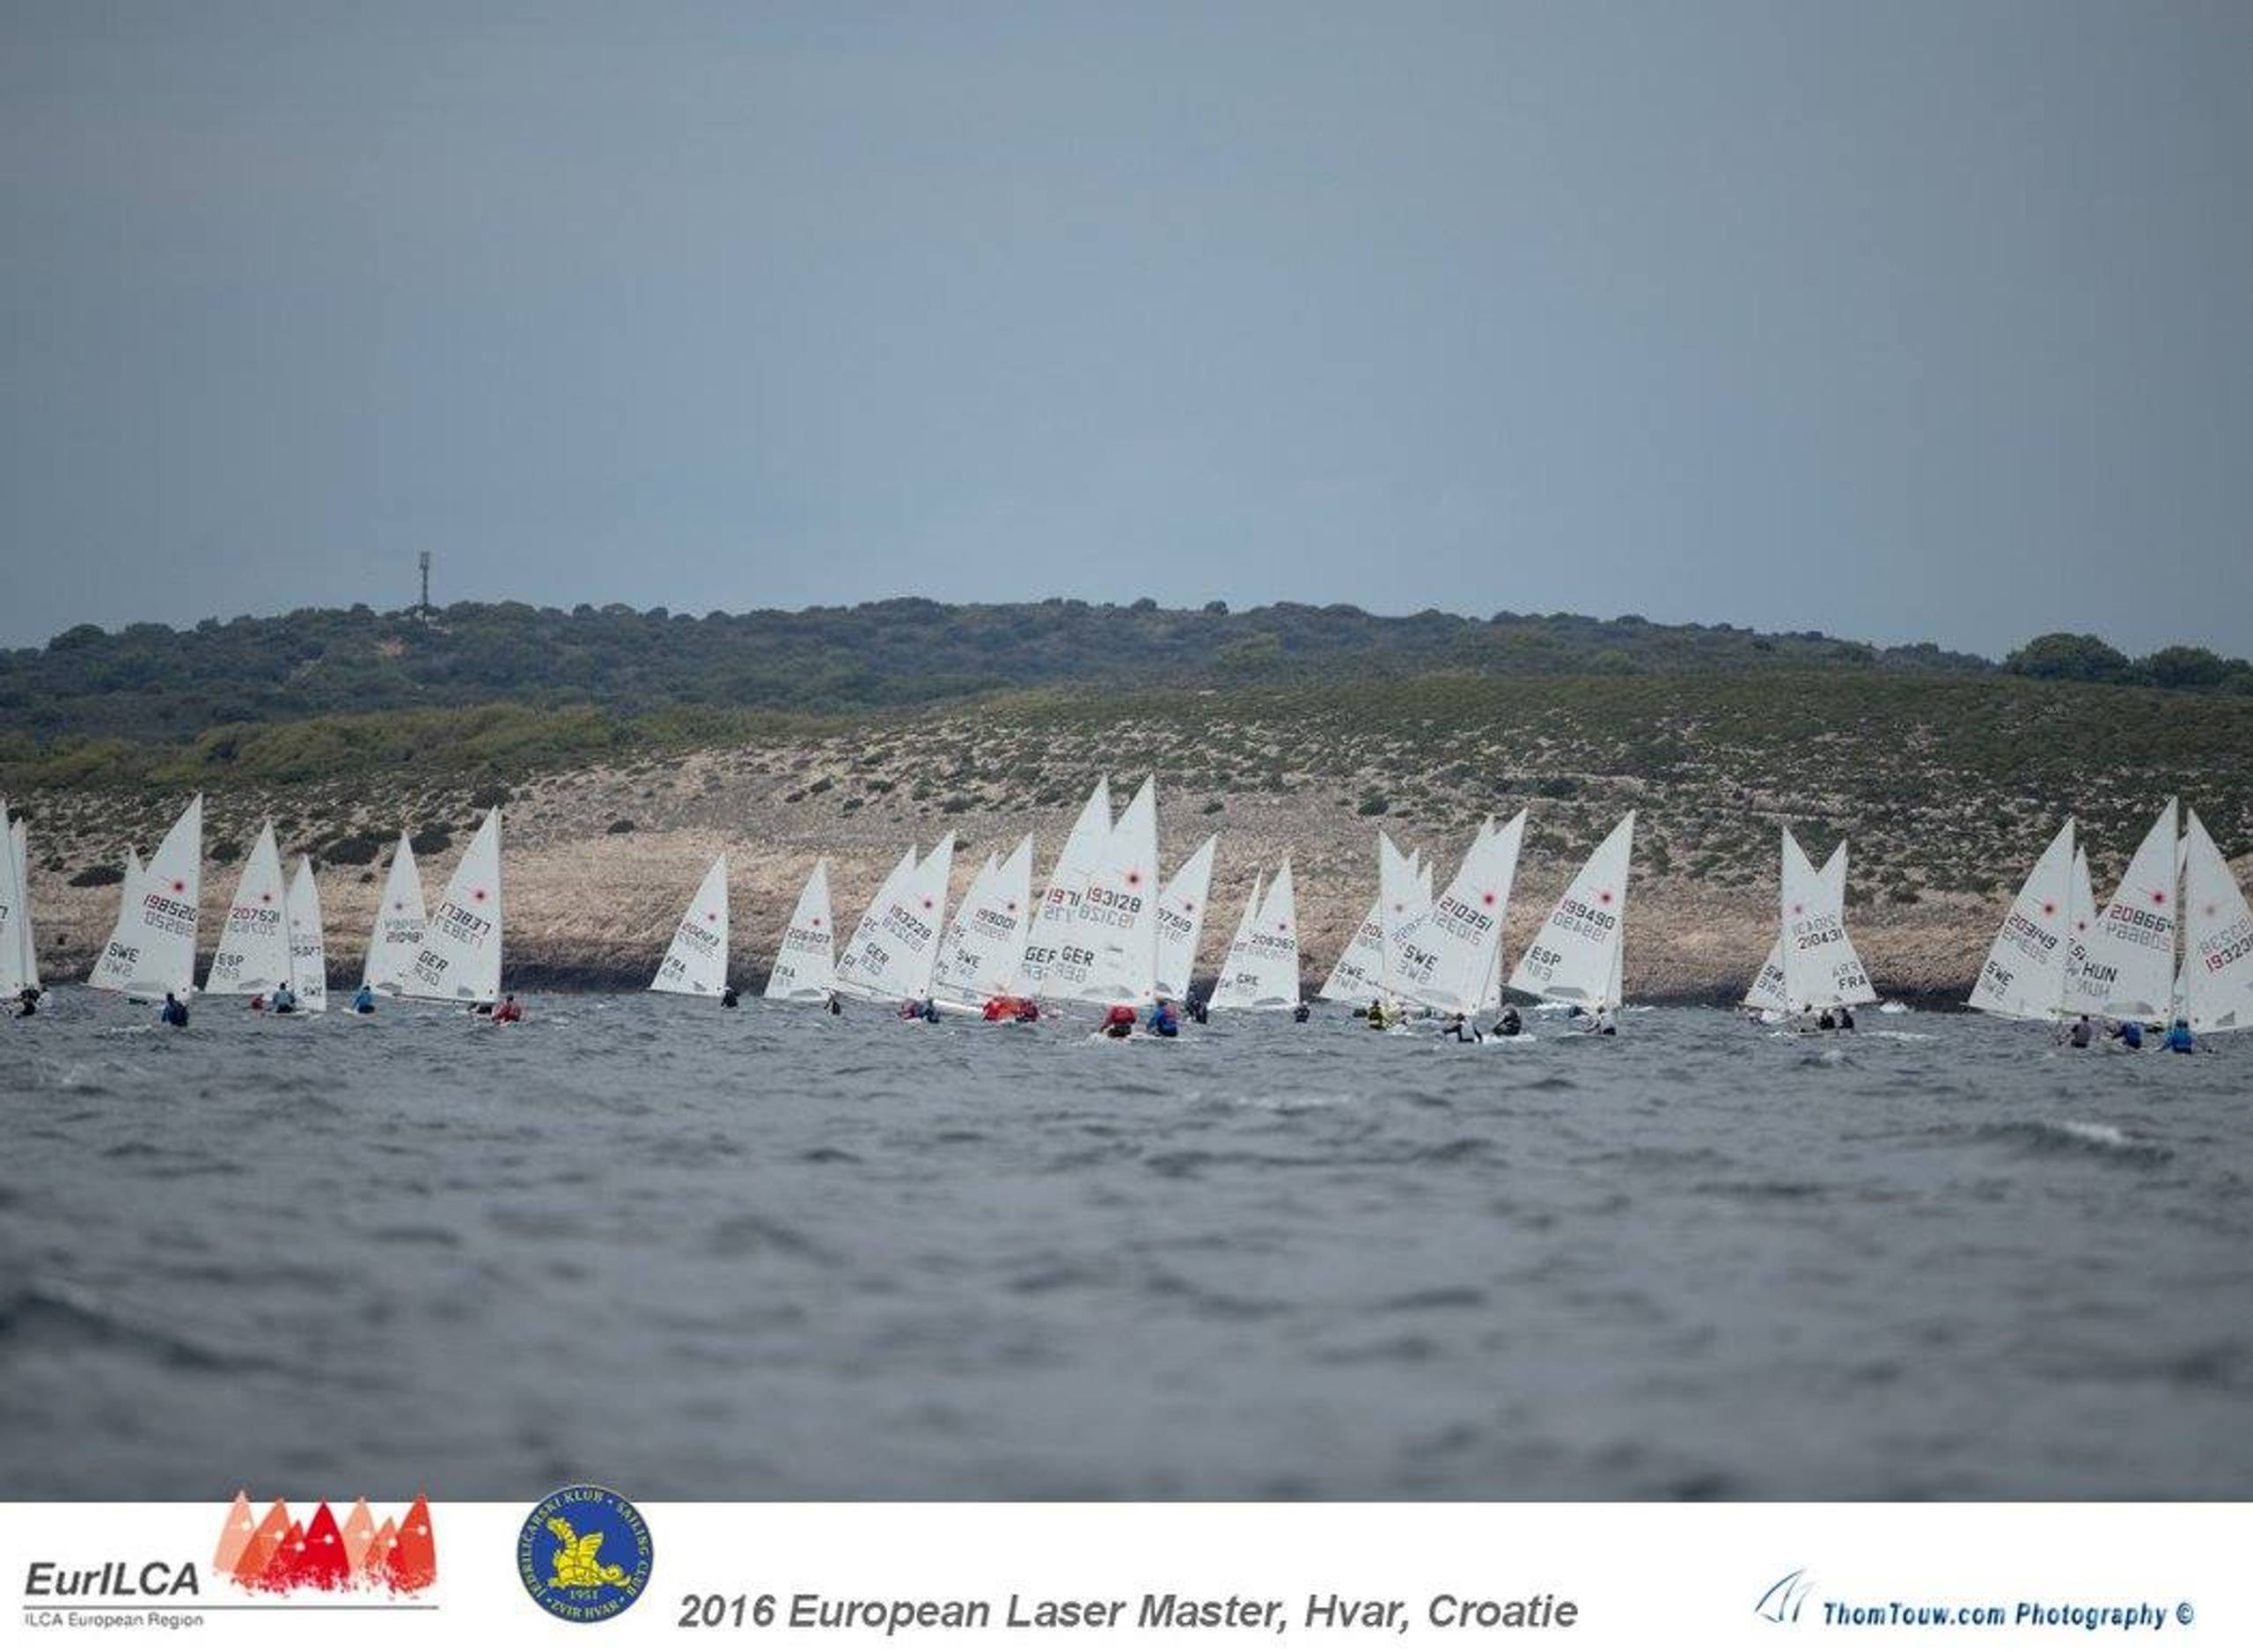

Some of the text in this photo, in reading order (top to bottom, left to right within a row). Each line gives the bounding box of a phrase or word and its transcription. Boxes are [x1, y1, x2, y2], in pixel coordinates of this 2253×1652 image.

[143, 893, 197, 922] 198520
[1085, 885, 1142, 913] 193128
[1439, 896, 1493, 932] 210351
[109, 942, 139, 964] SWE
[418, 950, 450, 972] GER
[1061, 945, 1095, 966] GER
[1404, 944, 1438, 973] SWE
[1530, 945, 1562, 966] ESP
[2082, 962, 2117, 983] HUN
